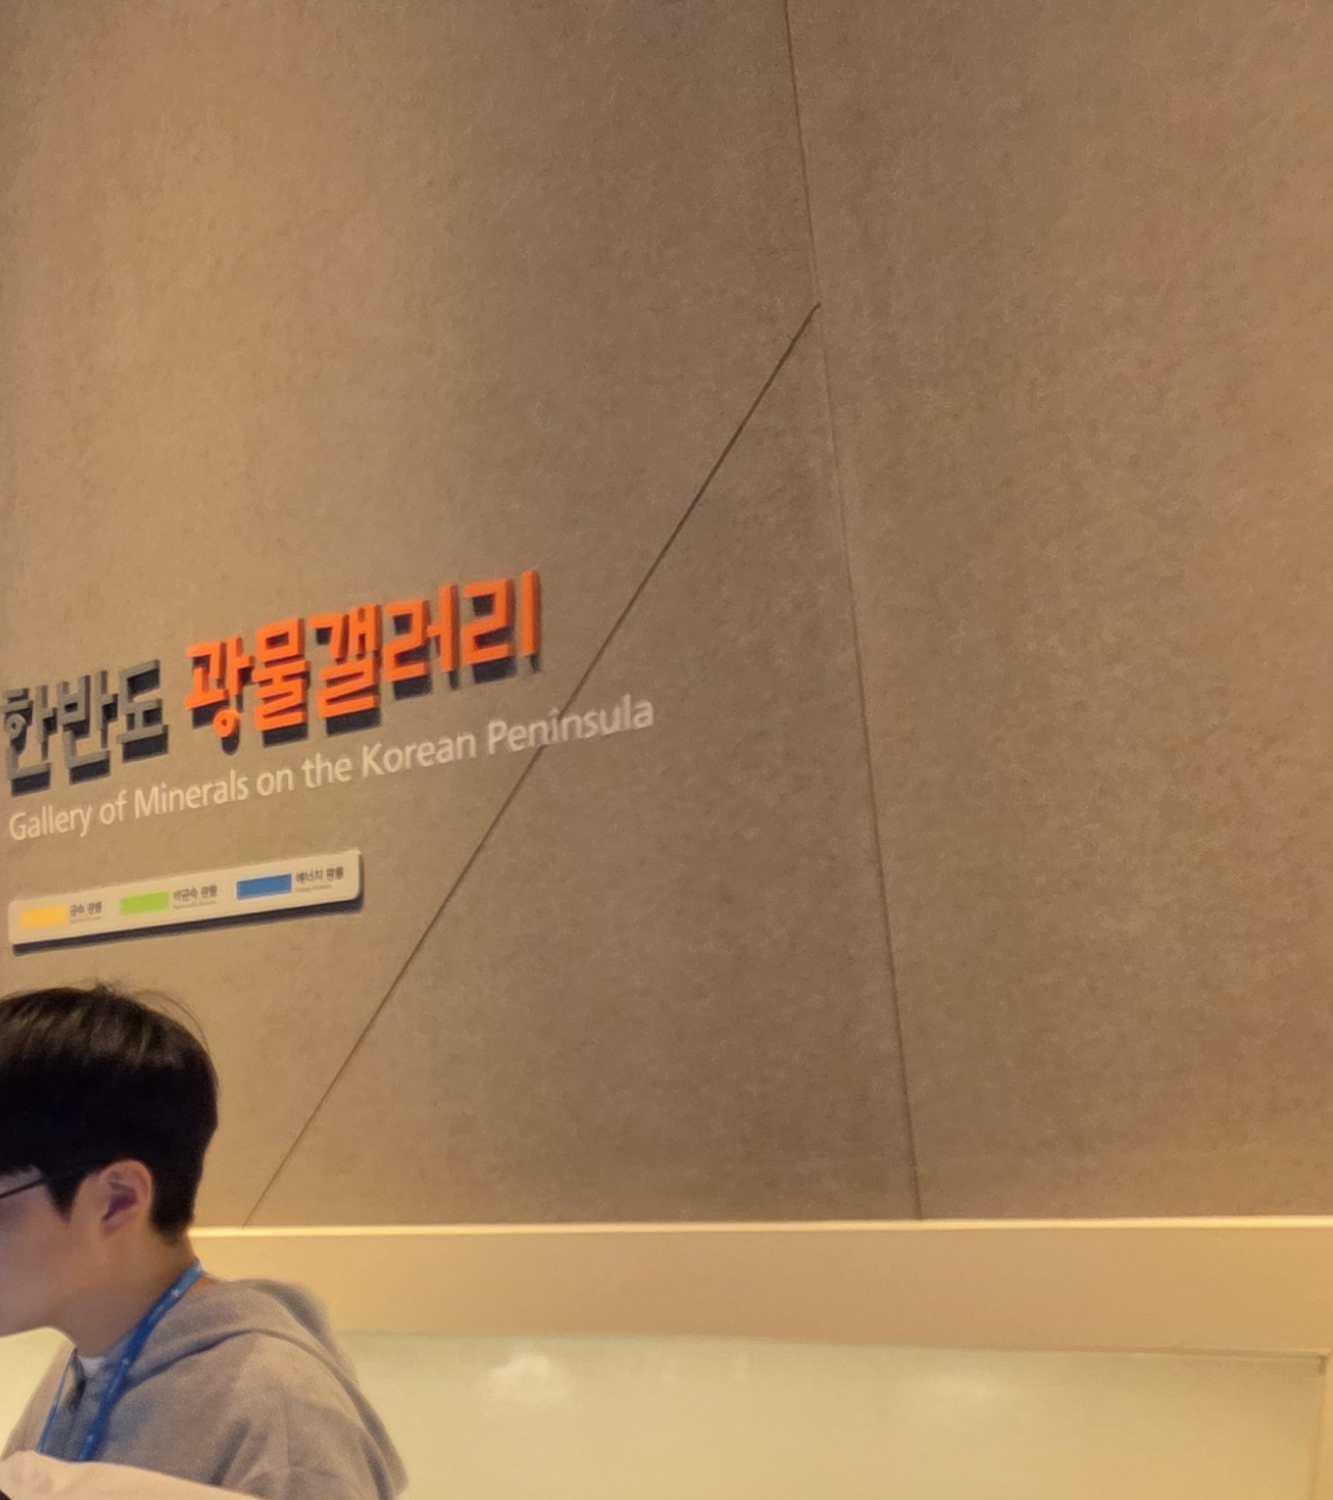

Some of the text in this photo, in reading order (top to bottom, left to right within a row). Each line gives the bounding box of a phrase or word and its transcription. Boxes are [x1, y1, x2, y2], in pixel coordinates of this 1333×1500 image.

[0, 570, 540, 782] 한반도 광물갤러리
[9, 692, 654, 840] Gallery of Minerals on the Korean Peninsula
